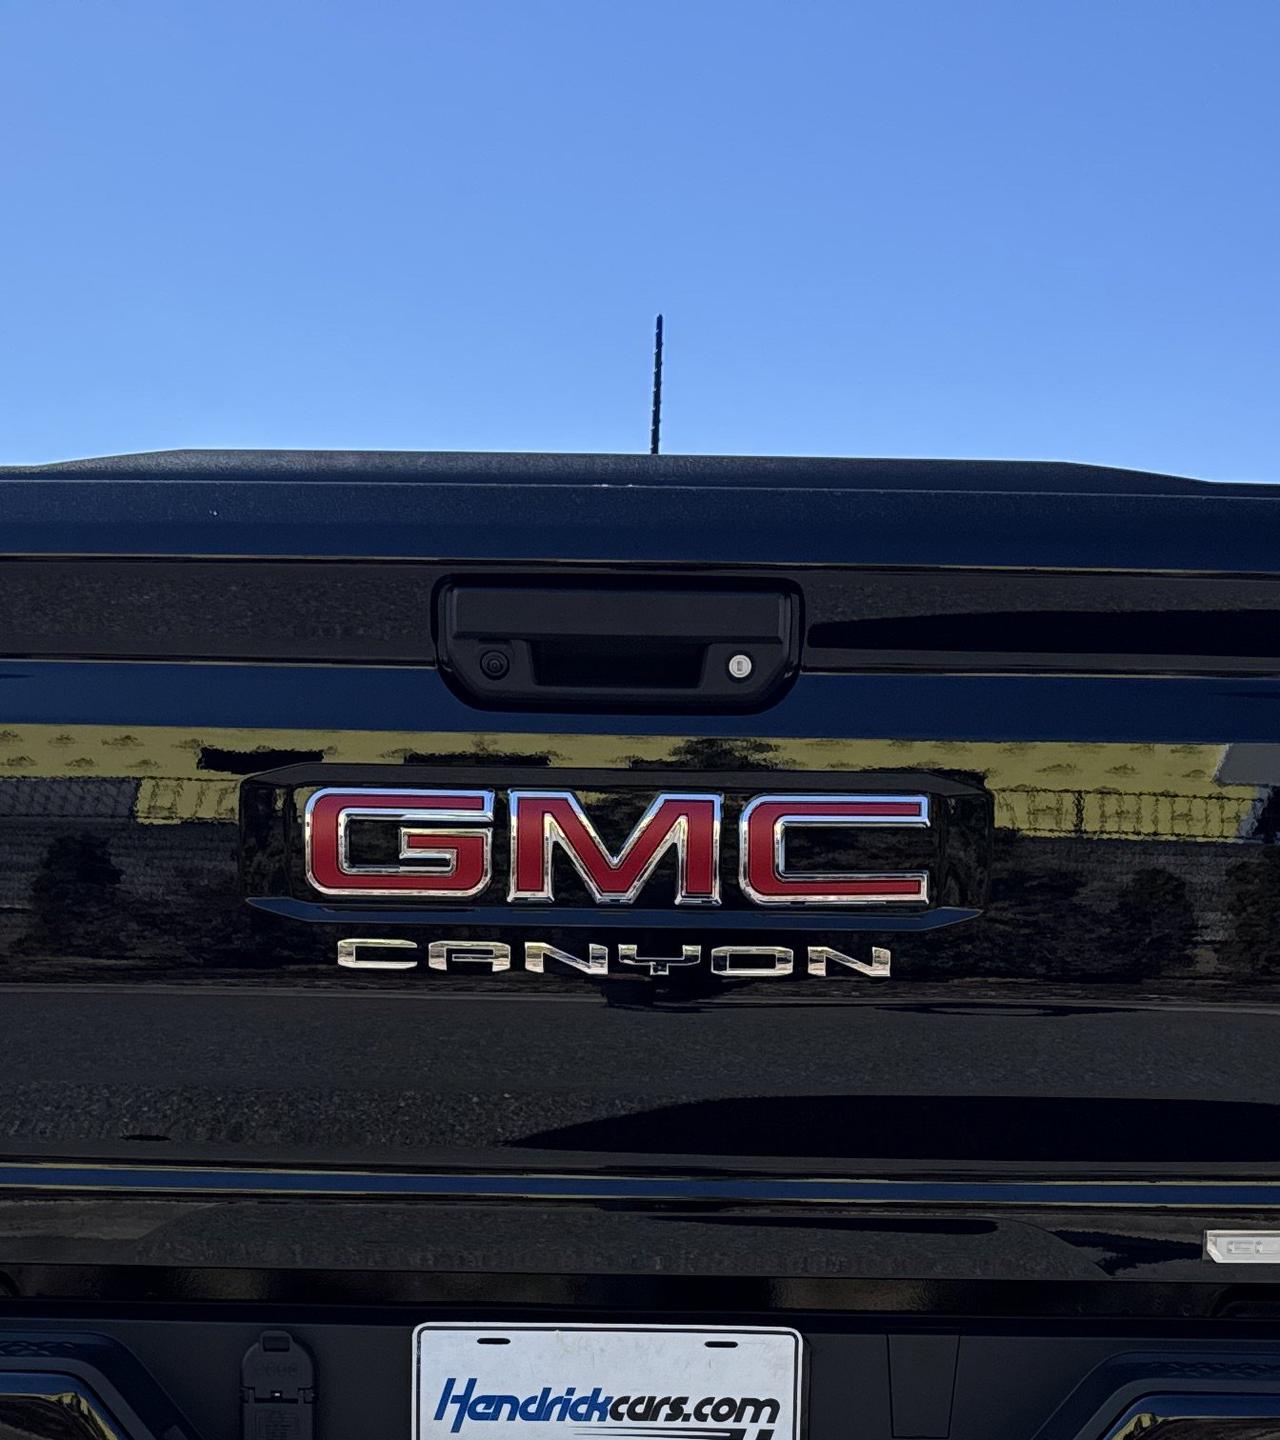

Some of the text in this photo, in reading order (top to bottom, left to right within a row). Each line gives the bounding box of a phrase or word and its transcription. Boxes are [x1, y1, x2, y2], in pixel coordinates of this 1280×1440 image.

[305, 787, 929, 905] GMC
[337, 938, 891, 977] CANYON
[433, 1378, 781, 1433] Hendrickcars.com
